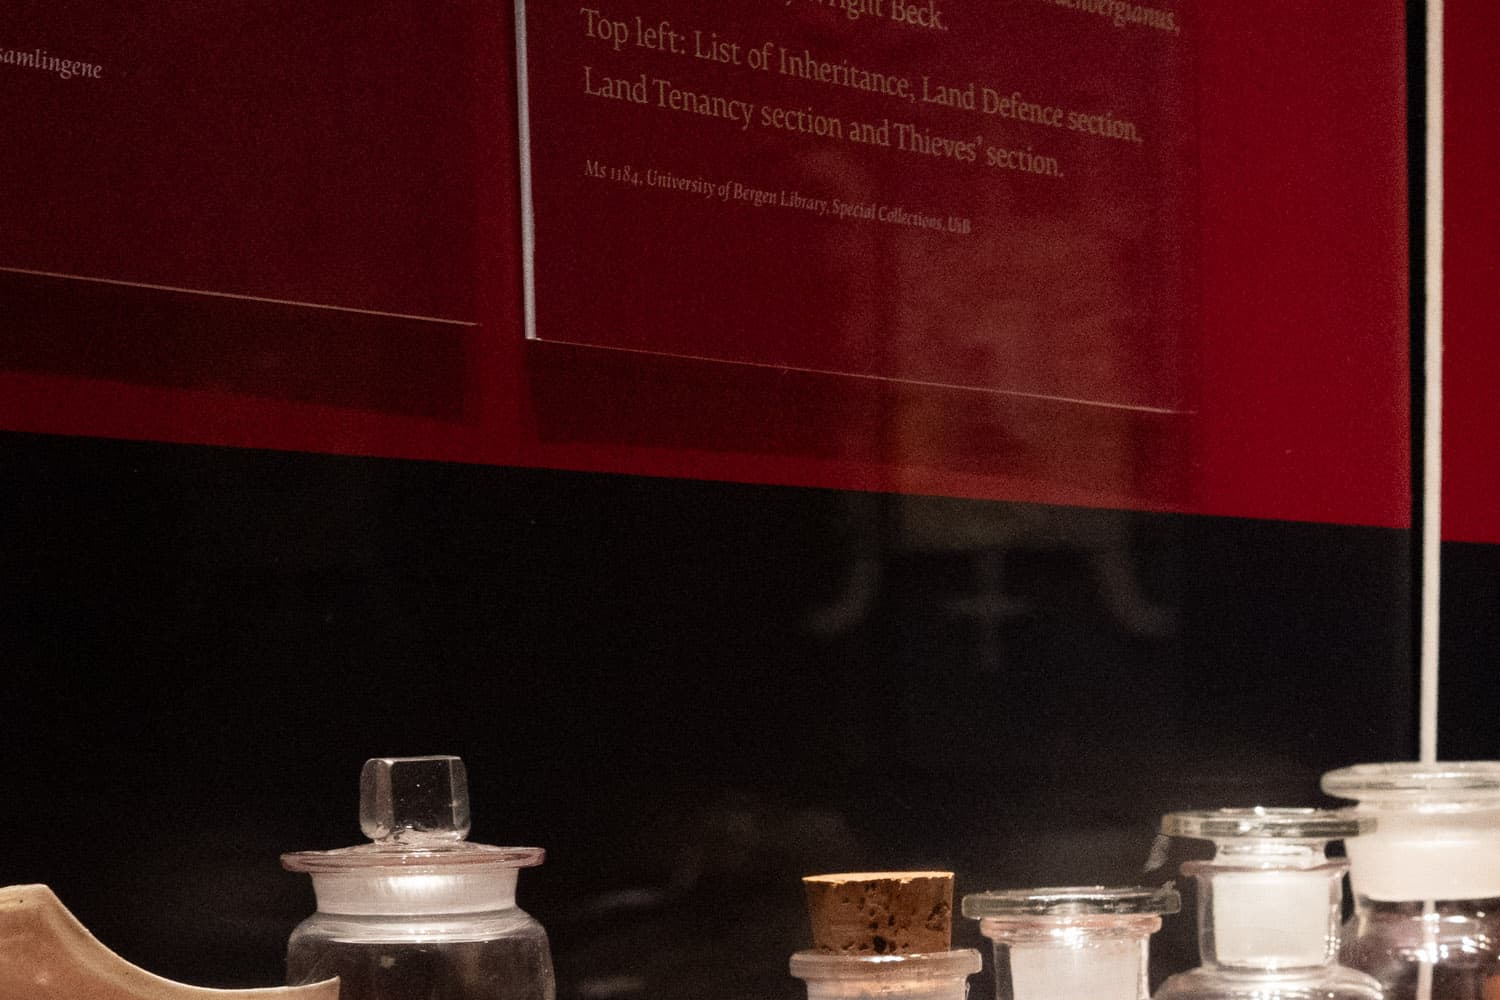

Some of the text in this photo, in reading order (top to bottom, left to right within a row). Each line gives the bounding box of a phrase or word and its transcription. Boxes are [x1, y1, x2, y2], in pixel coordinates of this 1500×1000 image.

[580, 7, 629, 52] Top
[635, 15, 686, 55] left:
[693, 29, 741, 66] List
[747, 41, 774, 71] of
[779, 47, 916, 104] Inheritance,
[921, 75, 976, 111] Land
[981, 87, 1064, 129] Defence
[583, 65, 649, 105] Land
[652, 78, 754, 131] Tenancy
[760, 104, 843, 140] section
[849, 118, 890, 148] and
[986, 145, 1065, 178] section.
[583, 158, 607, 179] Ms
[646, 167, 716, 200] University
[717, 179, 734, 202] of
[734, 182, 777, 208] Bergen
[832, 198, 877, 220] Special
